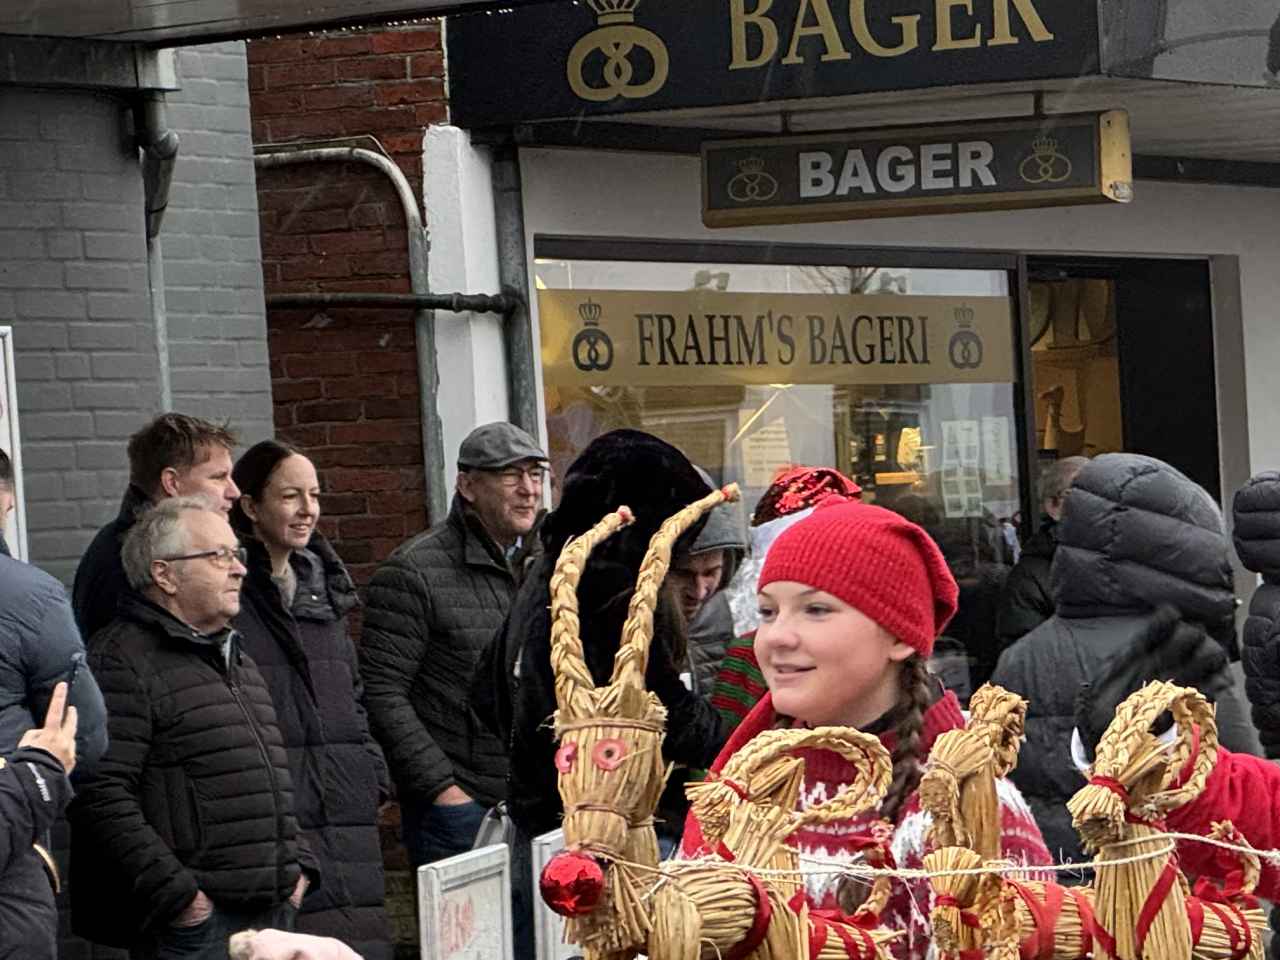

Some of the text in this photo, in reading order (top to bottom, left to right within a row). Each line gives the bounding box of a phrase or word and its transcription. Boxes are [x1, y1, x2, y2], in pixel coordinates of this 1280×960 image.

[800, 141, 996, 198] BAGER
[635, 310, 930, 367] FRAHM'S BAGERI
